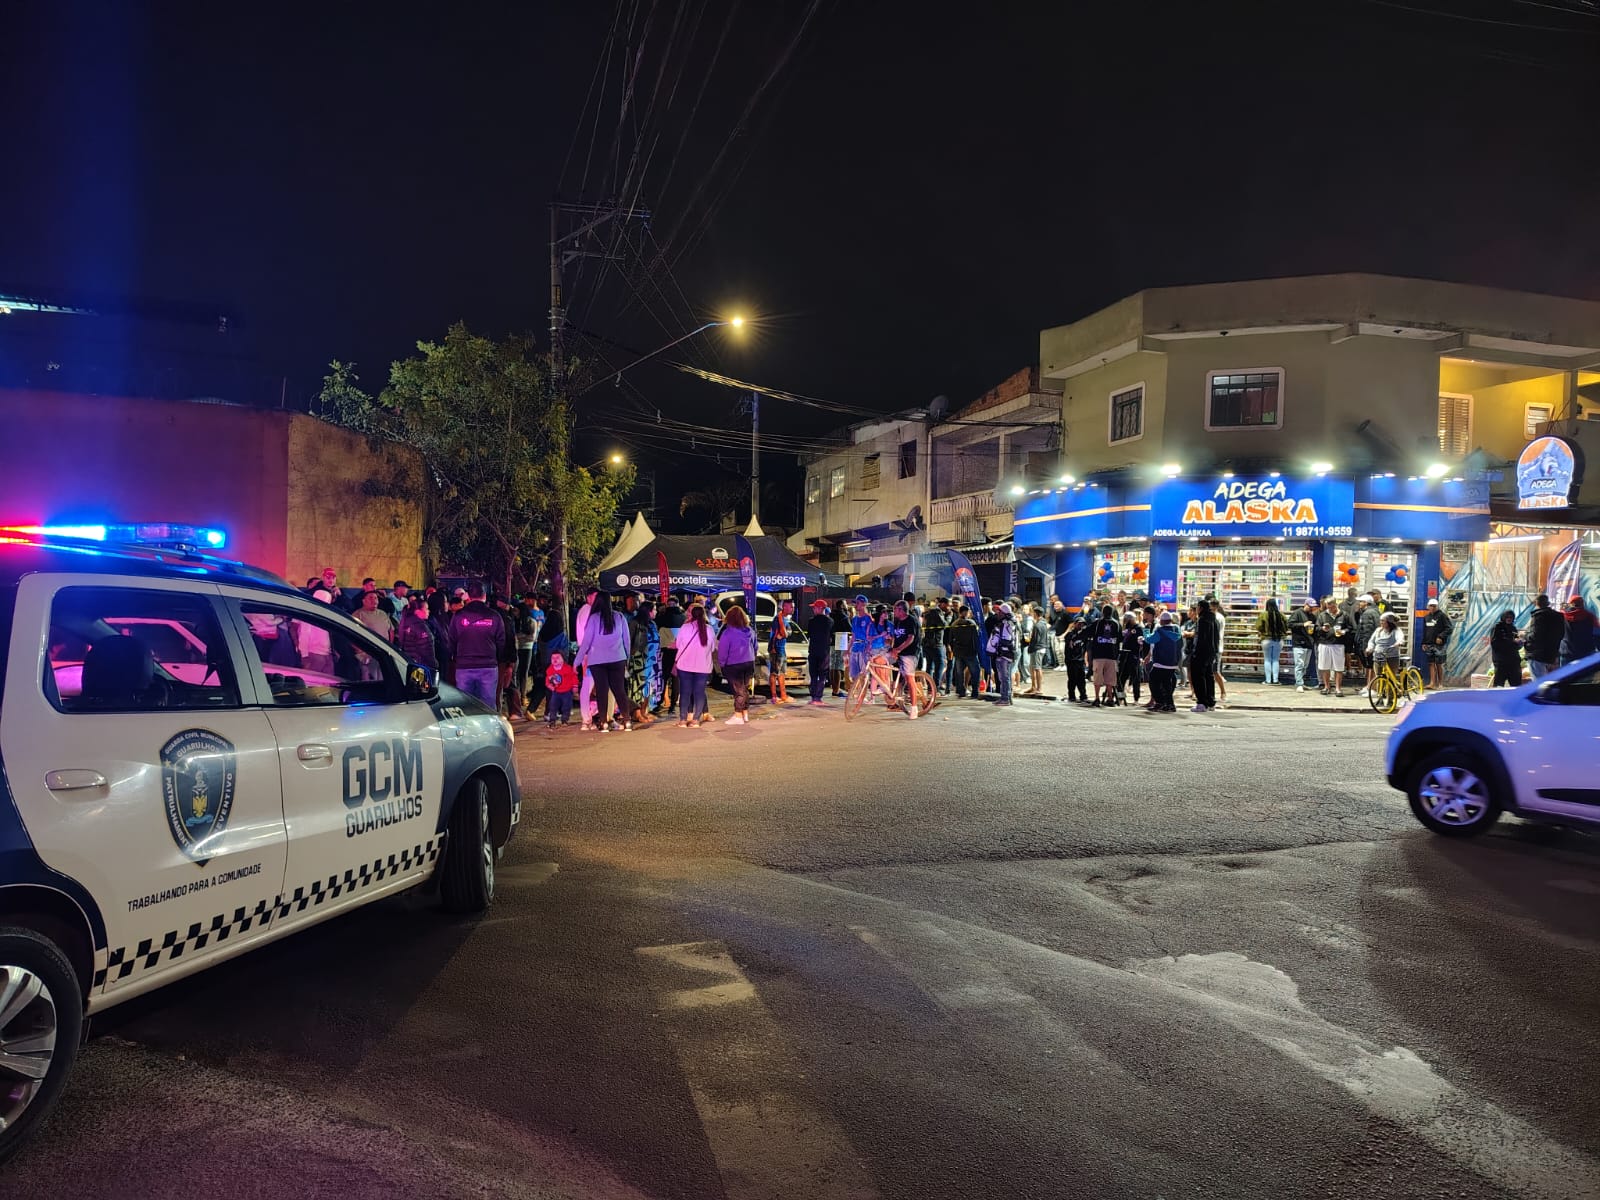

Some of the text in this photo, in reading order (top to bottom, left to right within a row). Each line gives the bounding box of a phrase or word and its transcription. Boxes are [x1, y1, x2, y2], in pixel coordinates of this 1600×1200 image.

[1214, 481, 1286, 499] ADEGA
[1531, 479, 1557, 489] ADEGA
[1519, 497, 1567, 508] ALASKA
[1182, 498, 1318, 524] ALASKA
[1282, 526, 1352, 537] 11 98711-9559
[630, 575, 714, 587] @atalacostela_
[184, 732, 199, 740] CIVIL
[176, 742, 220, 758] GUARULHOS
[342, 738, 423, 809] GCM
[345, 795, 423, 838] GUARULHOS
[127, 863, 262, 912] TRABALHANDO PARA A COMUNIDADE
